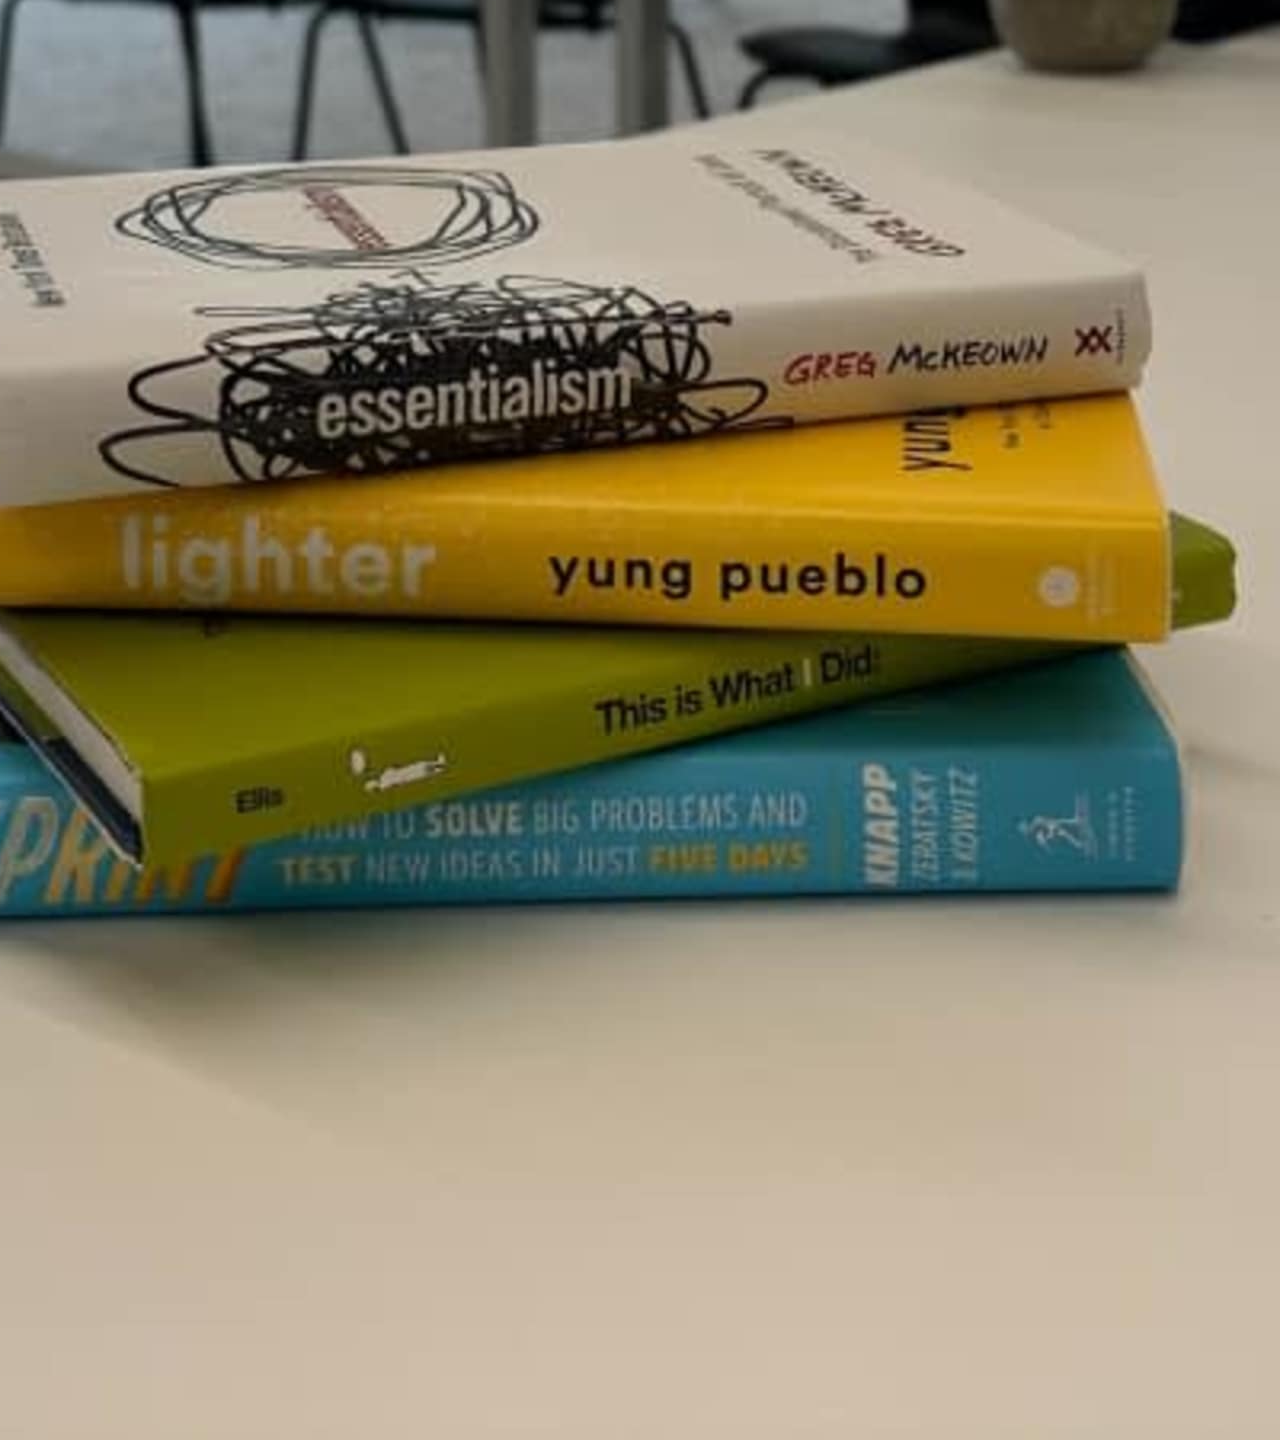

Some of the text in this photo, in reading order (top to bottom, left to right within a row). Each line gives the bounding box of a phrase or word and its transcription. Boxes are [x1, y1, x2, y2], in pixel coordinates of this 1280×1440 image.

[316, 359, 637, 439] essentialism
[783, 351, 878, 386] GREG
[901, 406, 973, 471] yun
[122, 512, 436, 605] lighter
[548, 553, 928, 601] yung pueblo
[594, 693, 667, 737] This
[675, 684, 703, 716] is
[709, 661, 796, 708] What
[381, 809, 416, 841] TO
[424, 802, 523, 838] SOLVE
[532, 798, 581, 835] BIG
[590, 792, 738, 832] PROBLEMS
[748, 790, 808, 829] AND
[861, 763, 899, 888] KNAPP
[949, 763, 979, 862] KOWITZ
[281, 839, 809, 886] TEST NEW IDEAS IN JUST FIVE DAYS
